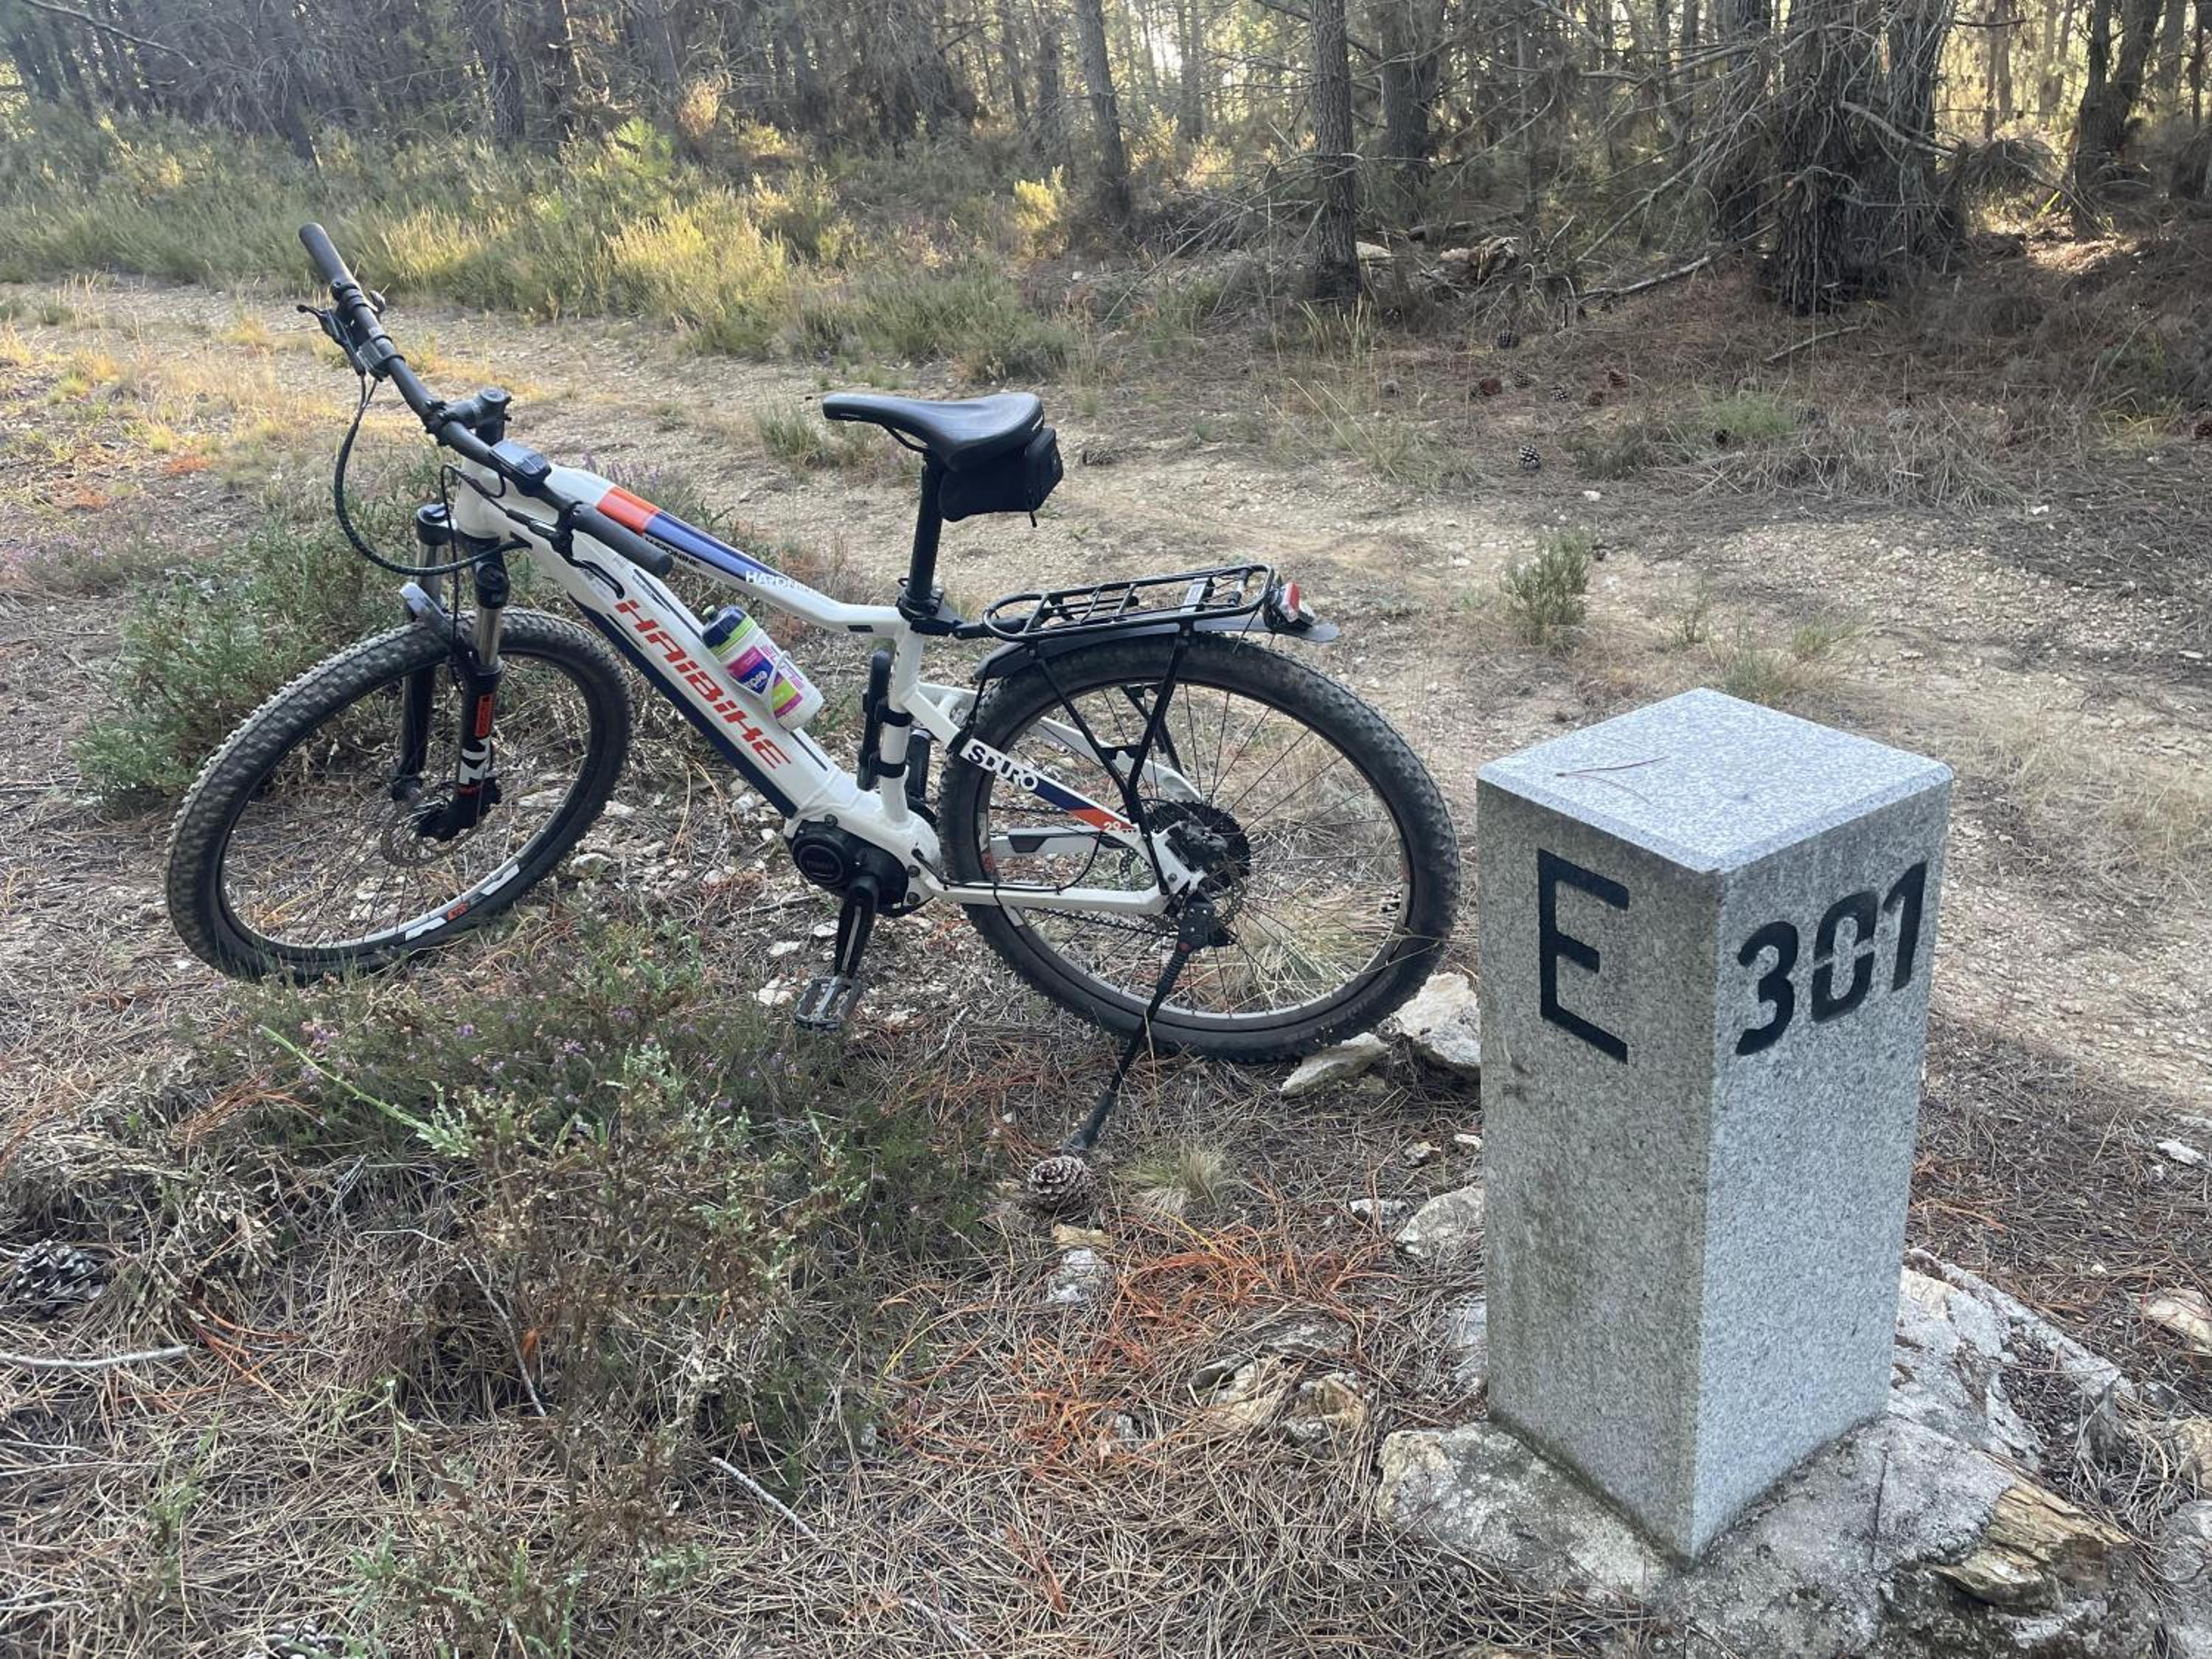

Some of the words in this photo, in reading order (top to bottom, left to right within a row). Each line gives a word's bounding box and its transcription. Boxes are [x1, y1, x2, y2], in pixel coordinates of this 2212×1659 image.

[967, 743, 1039, 791] SDURO
[1537, 848, 1629, 1065] E
[1735, 860, 1927, 1056] 301
